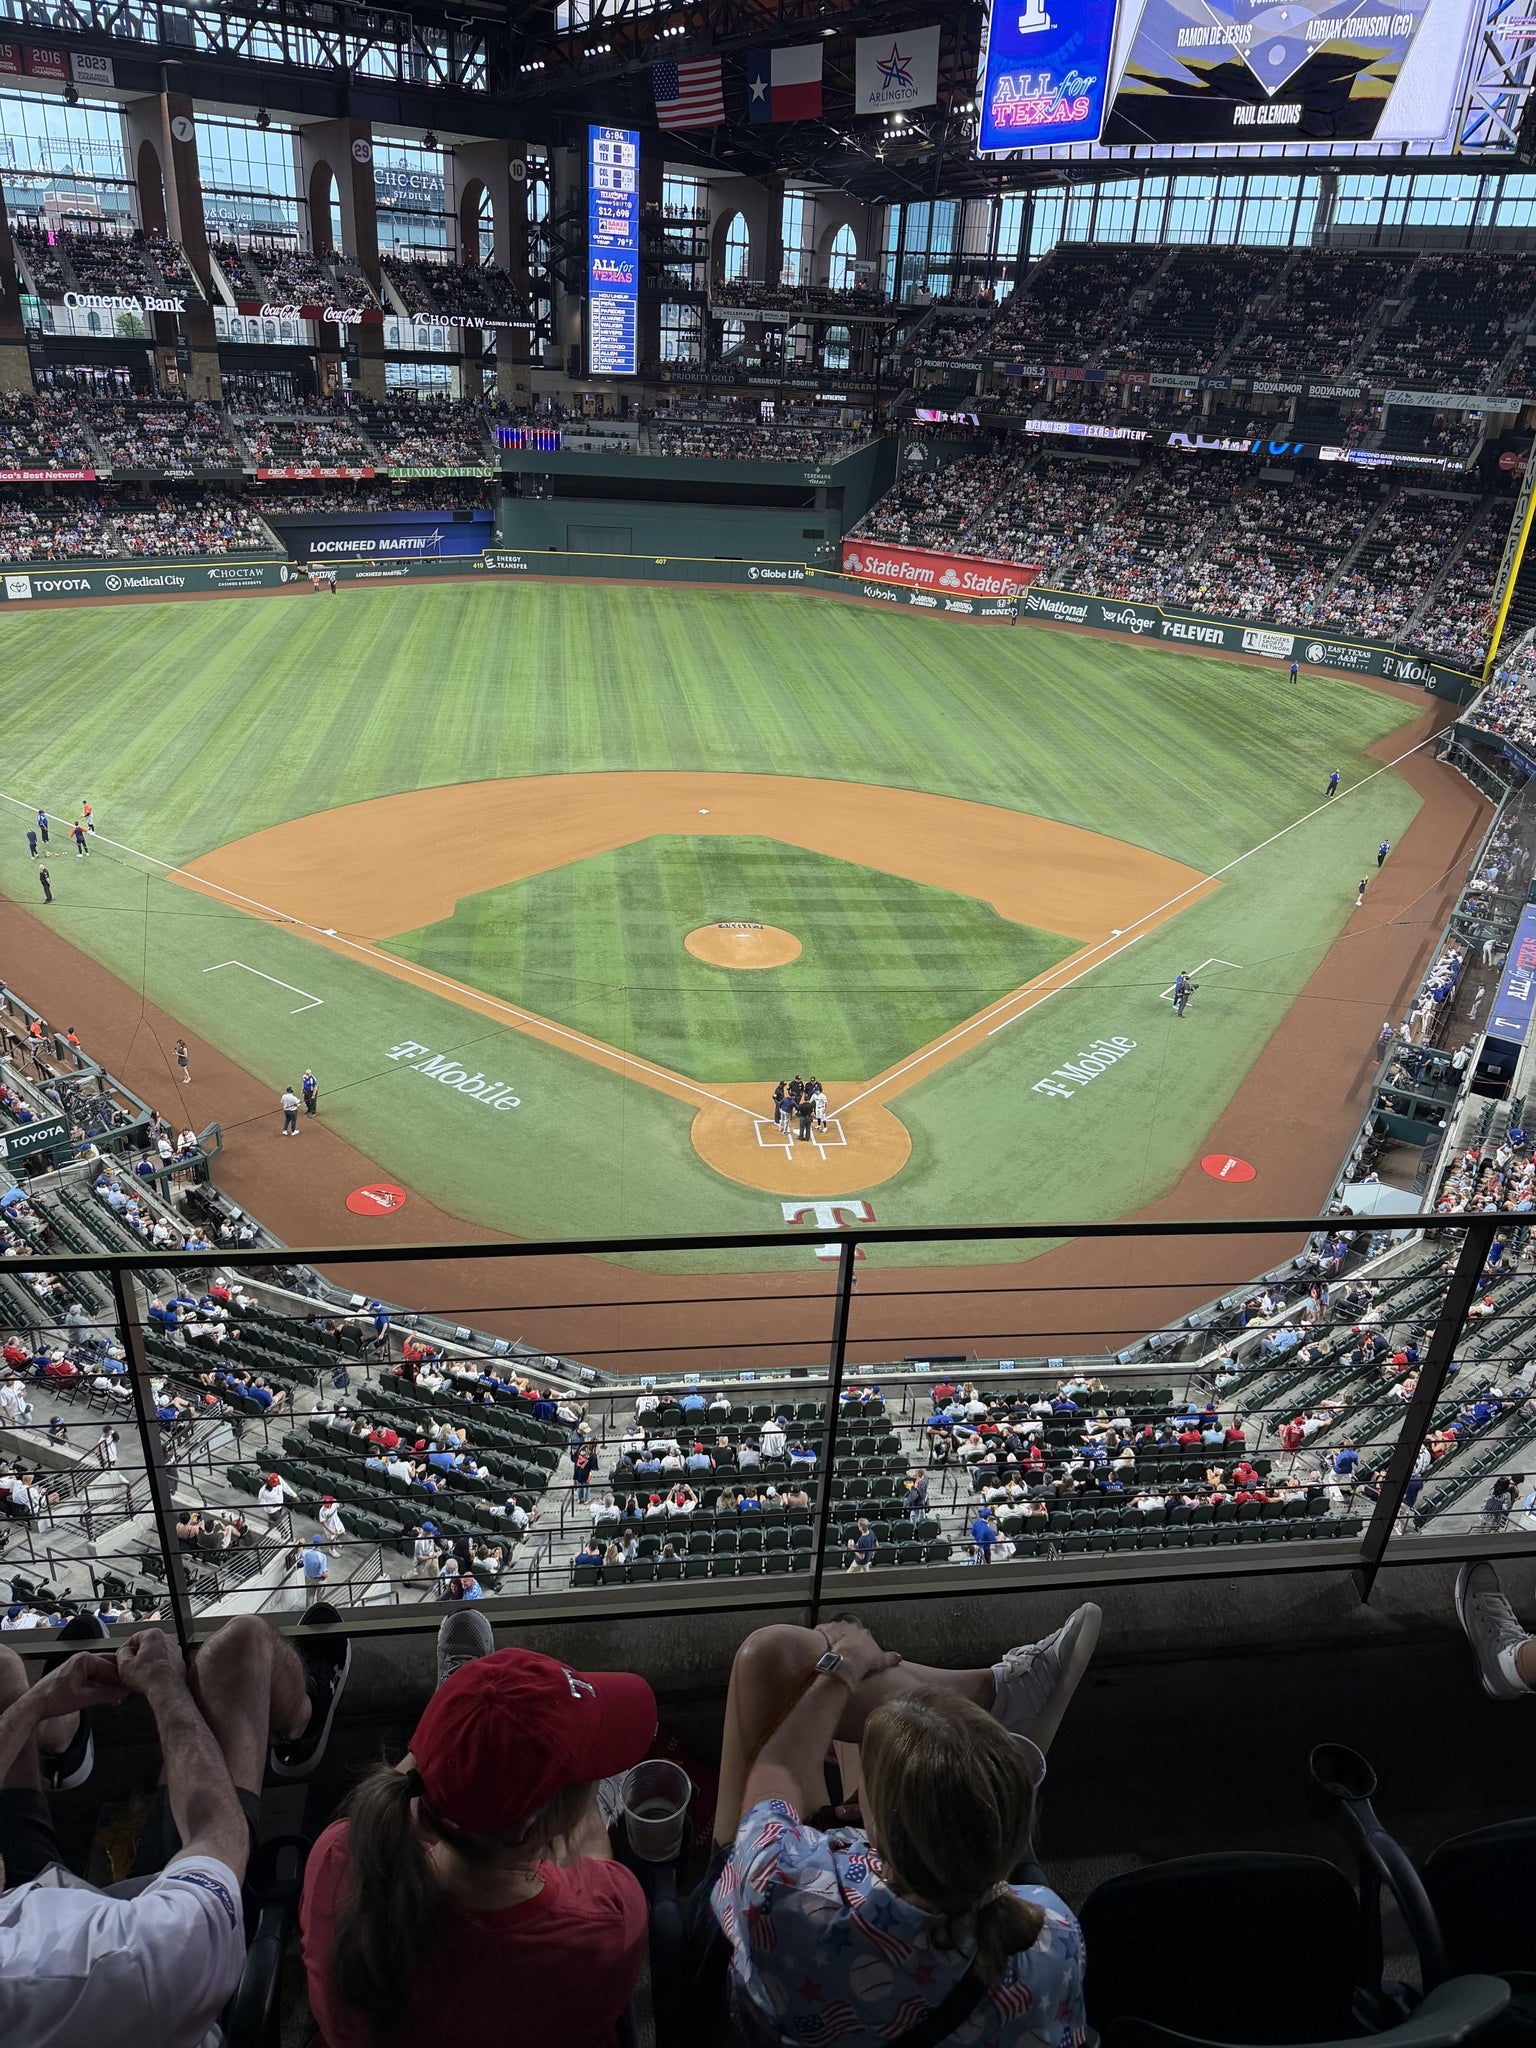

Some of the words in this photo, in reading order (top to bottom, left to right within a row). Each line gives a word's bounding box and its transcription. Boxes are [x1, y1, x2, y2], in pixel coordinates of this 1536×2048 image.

[1305, 19, 1340, 40] ADRIAN
[1340, 15, 1391, 38] JOHNSON
[1177, 26, 1210, 47] RAMON
[1210, 26, 1223, 45] DE
[1222, 24, 1253, 44] JESUS
[33, 49, 61, 65] 2016
[77, 56, 107, 71] 2023
[32, 69, 65, 78] CHAMPIONS
[78, 75, 110, 84] CHAMPIONS
[869, 89, 919, 103] ARLINGTON
[993, 74, 1058, 103] ALL
[1046, 70, 1097, 113] for
[992, 97, 1090, 128] TEXAS
[1233, 106, 1257, 126] PAUL
[1257, 105, 1302, 124] CLEMONS
[178, 121, 187, 136] 7
[606, 130, 624, 140] 6:04
[354, 144, 370, 159] 29
[600, 153, 609, 161] TEX
[513, 164, 523, 177] 10
[394, 191, 431, 201] STADIUM
[599, 207, 630, 218] $12,690
[593, 259, 618, 272] ALL
[615, 261, 634, 278] for
[593, 270, 633, 284] TEXAS
[144, 296, 187, 313] Bank
[260, 303, 302, 320] Coca-Cola
[323, 307, 365, 324] Coca-Cola
[421, 313, 485, 328] CHOCTAW
[924, 360, 950, 369] PRIORITY
[951, 363, 983, 371] COMMERCE
[1023, 366, 1046, 376] 105.3
[672, 372, 710, 382] PRIORITY
[712, 374, 735, 383] GOLD
[749, 377, 781, 385] HARGROVE
[1127, 374, 1148, 383] PGL
[1152, 377, 1196, 387] GoPGL.com
[832, 382, 878, 391] PLUCKERS
[1208, 381, 1228, 389] PGL
[1253, 382, 1303, 394] BODYARMOR
[1309, 386, 1361, 398] BODYARMOR
[1387, 391, 1413, 404] Blue
[1417, 394, 1450, 407] Mint
[1025, 420, 1041, 431] SILVER
[1053, 422, 1070, 433] SERIES
[1084, 425, 1110, 438] TEXAS
[1112, 429, 1148, 441] LOTTERY
[23, 472, 48, 480] Best
[49, 472, 85, 480] Network
[400, 468, 437, 478] LUXOR
[440, 467, 492, 478] STAFFING
[310, 540, 376, 553] LOCKHEED
[379, 538, 426, 551] MARTIN
[214, 568, 264, 579] CHOCTAW
[761, 570, 787, 579] Globe
[788, 570, 804, 579] Life
[34, 579, 91, 592] TOYOTA
[123, 576, 164, 588] Medical
[165, 575, 186, 588] City
[864, 586, 898, 601] Kubota
[1054, 613, 1064, 621] Car
[1065, 615, 1084, 624] Rental
[1117, 609, 1156, 634] Kroger
[1246, 632, 1258, 647] T
[1263, 635, 1290, 644] RANGERS
[1262, 644, 1291, 653] NETWORK
[1328, 646, 1346, 655] EAST
[1347, 649, 1372, 659] TEXAS
[1325, 660, 1369, 670] UNIVERSITY
[1337, 655, 1357, 663] A&M
[11, 1126, 65, 1148] TOYOTA
